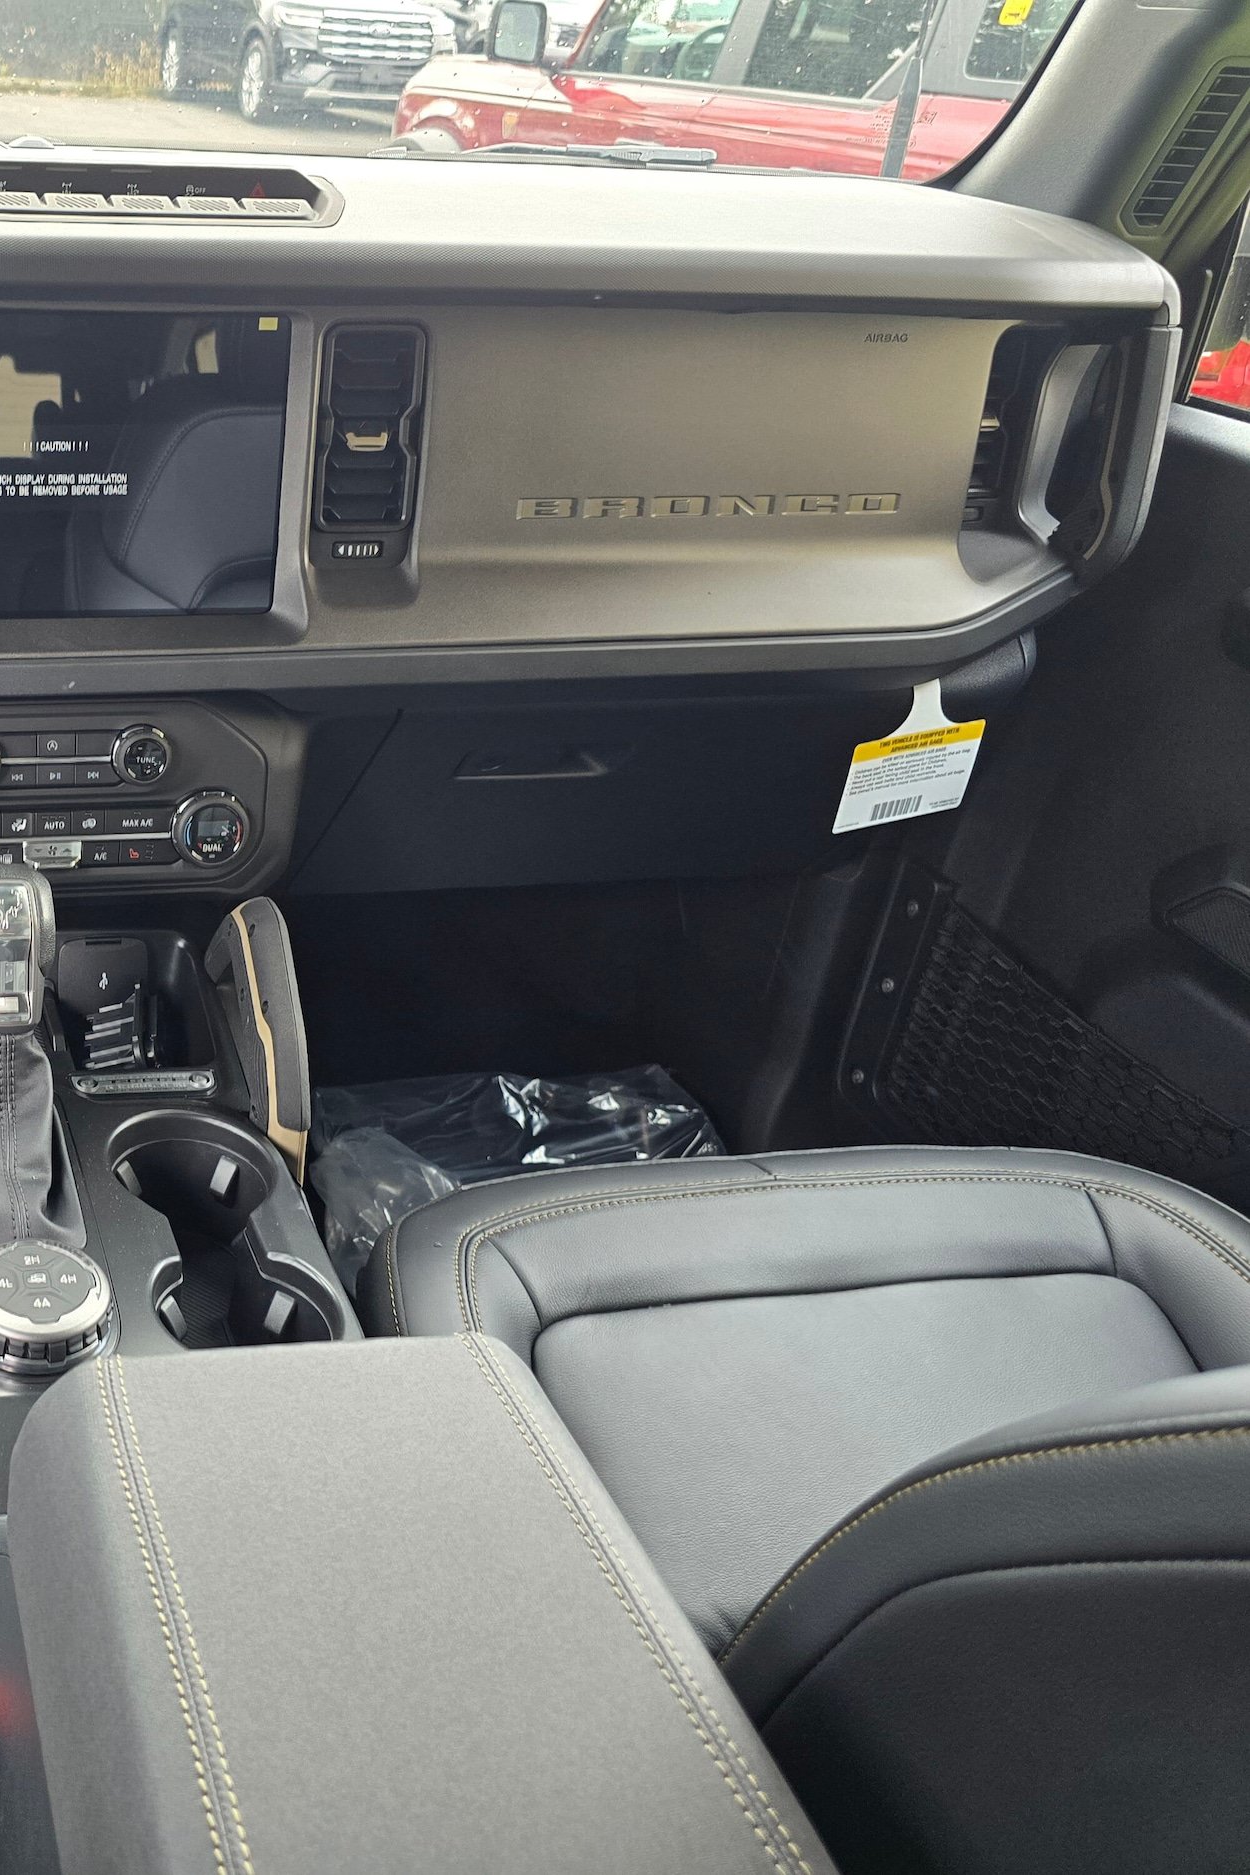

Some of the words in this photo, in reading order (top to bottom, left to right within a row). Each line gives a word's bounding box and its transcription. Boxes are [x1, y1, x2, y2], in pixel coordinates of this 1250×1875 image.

[864, 333, 909, 344] AIRBAG
[15, 473, 45, 485] DISPLAY
[48, 473, 75, 485] DURING
[78, 473, 128, 484] INSTALLATION
[5, 486, 16, 496] TO
[18, 485, 30, 496] BE
[32, 485, 68, 496] REMOVED
[71, 485, 100, 496] BEFORE
[103, 485, 128, 495] USAGE
[516, 492, 902, 520] BRONCO
[920, 731, 945, 739] EQUIPPED
[890, 743, 917, 752] ADVANCED
[136, 756, 156, 764] TUNE
[44, 821, 65, 830] AUTO
[122, 819, 139, 828] MAX
[140, 818, 154, 828] A/C
[202, 843, 223, 853] DUAL
[93, 851, 108, 861] A/C
[23, 1254, 41, 1266] 2H
[60, 1274, 78, 1285] 4H
[33, 1297, 51, 1309] 4A
